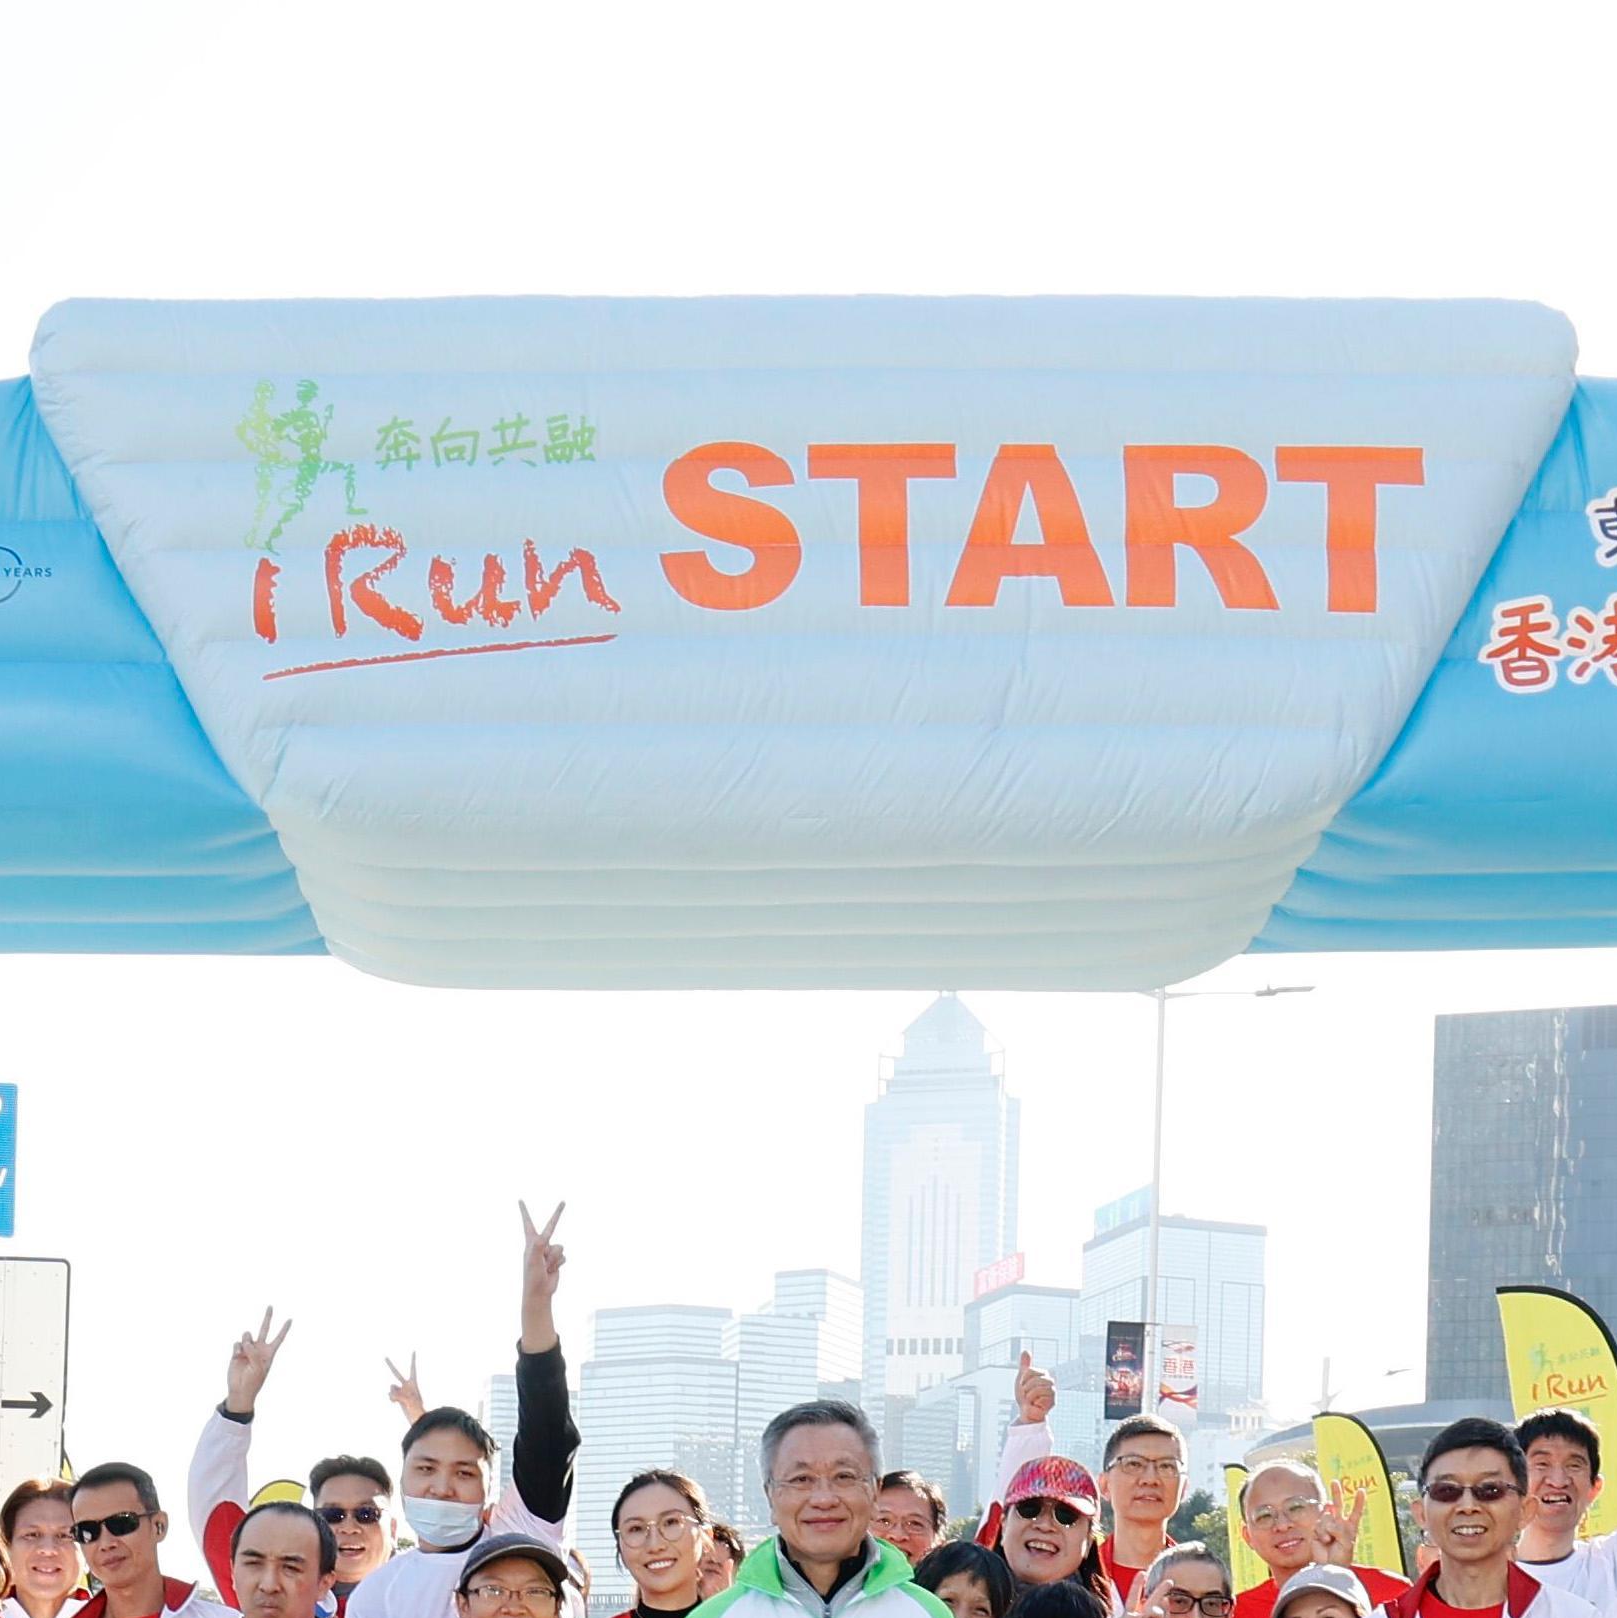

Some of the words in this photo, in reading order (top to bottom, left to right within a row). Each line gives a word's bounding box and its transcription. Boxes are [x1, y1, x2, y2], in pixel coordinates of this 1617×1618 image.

[376, 413, 597, 471] 奔向共融
[659, 441, 1425, 614] START
[3, 567, 53, 578] YEARS
[324, 523, 622, 641] Run
[1547, 1373, 1608, 1399] Run
